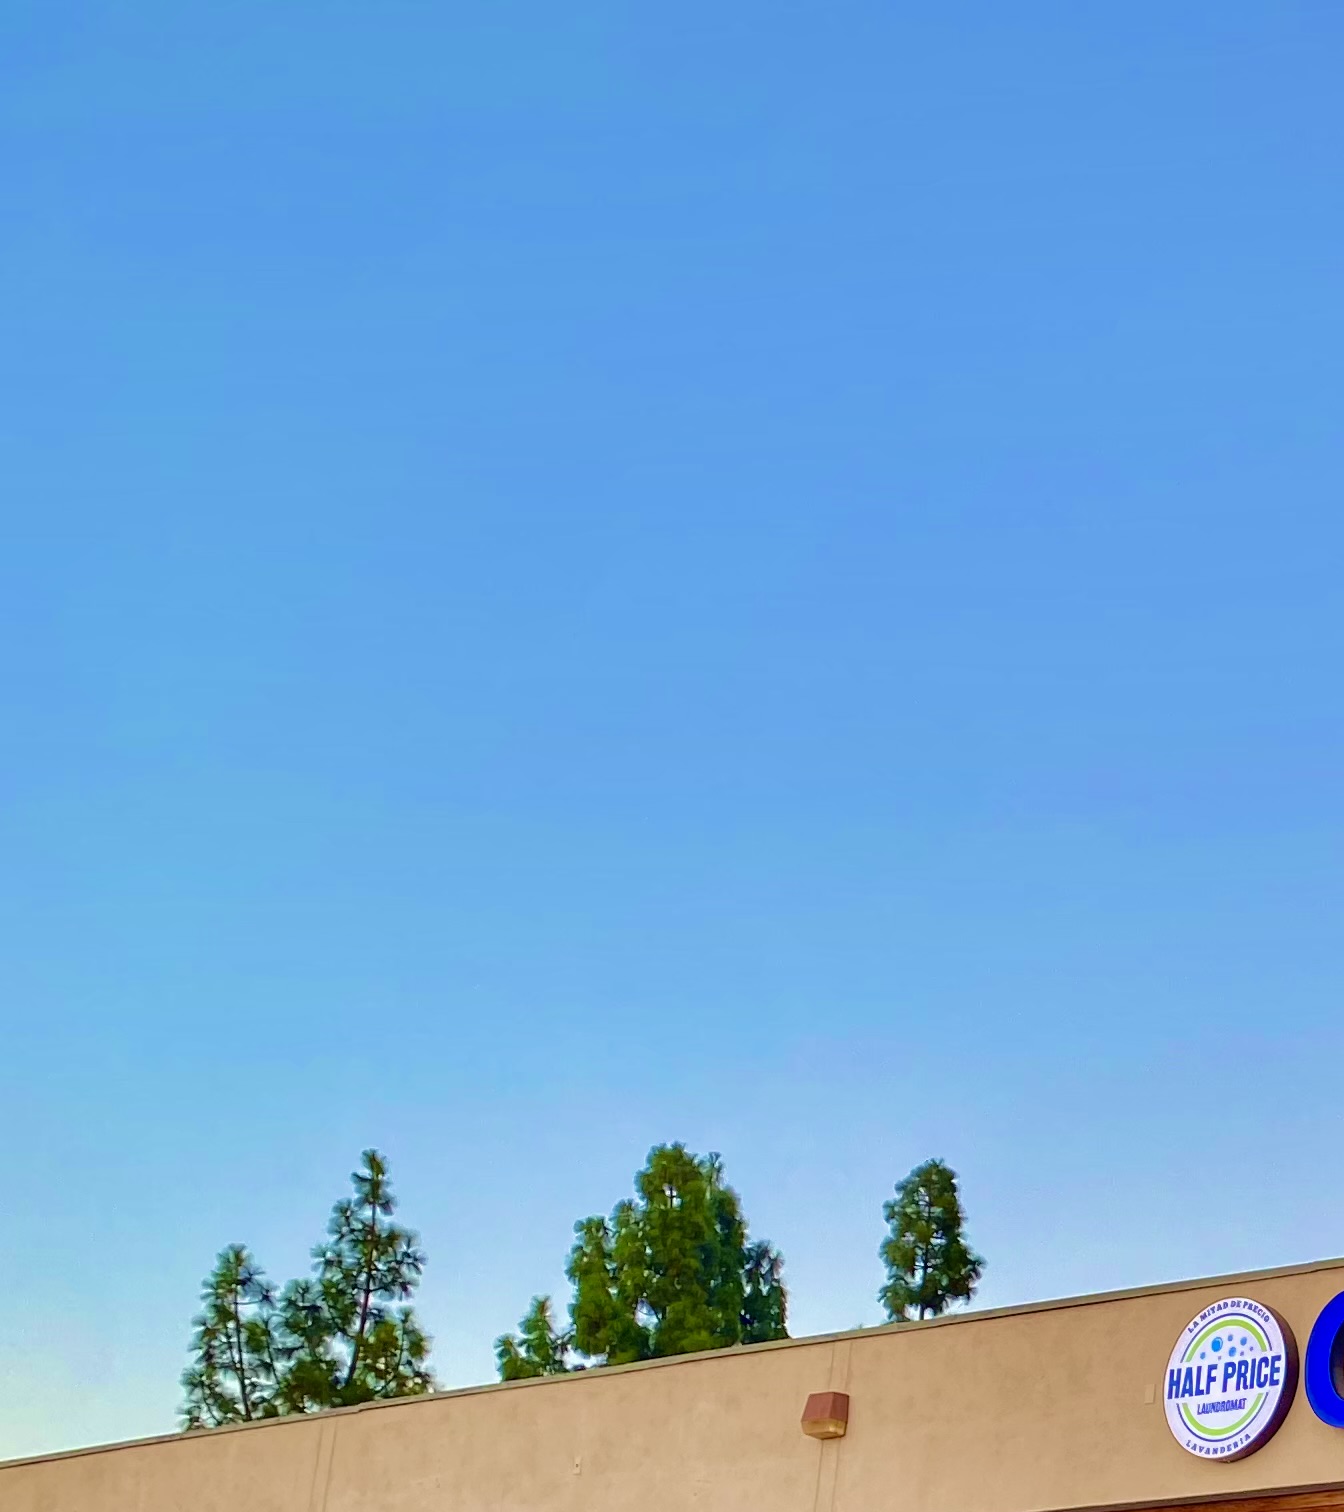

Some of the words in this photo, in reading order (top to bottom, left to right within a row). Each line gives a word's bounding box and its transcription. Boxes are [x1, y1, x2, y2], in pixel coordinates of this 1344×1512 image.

[1187, 1322, 1199, 1333] LA
[1200, 1302, 1229, 1321] MITAD
[1230, 1300, 1241, 1308] DE
[1242, 1301, 1270, 1323] PRECIO
[1167, 1363, 1218, 1400] HALF
[1222, 1354, 1282, 1393] PRICE
[1196, 1398, 1248, 1415] LAUNDROMAT
[1186, 1433, 1252, 1455] LAVANDERIA
